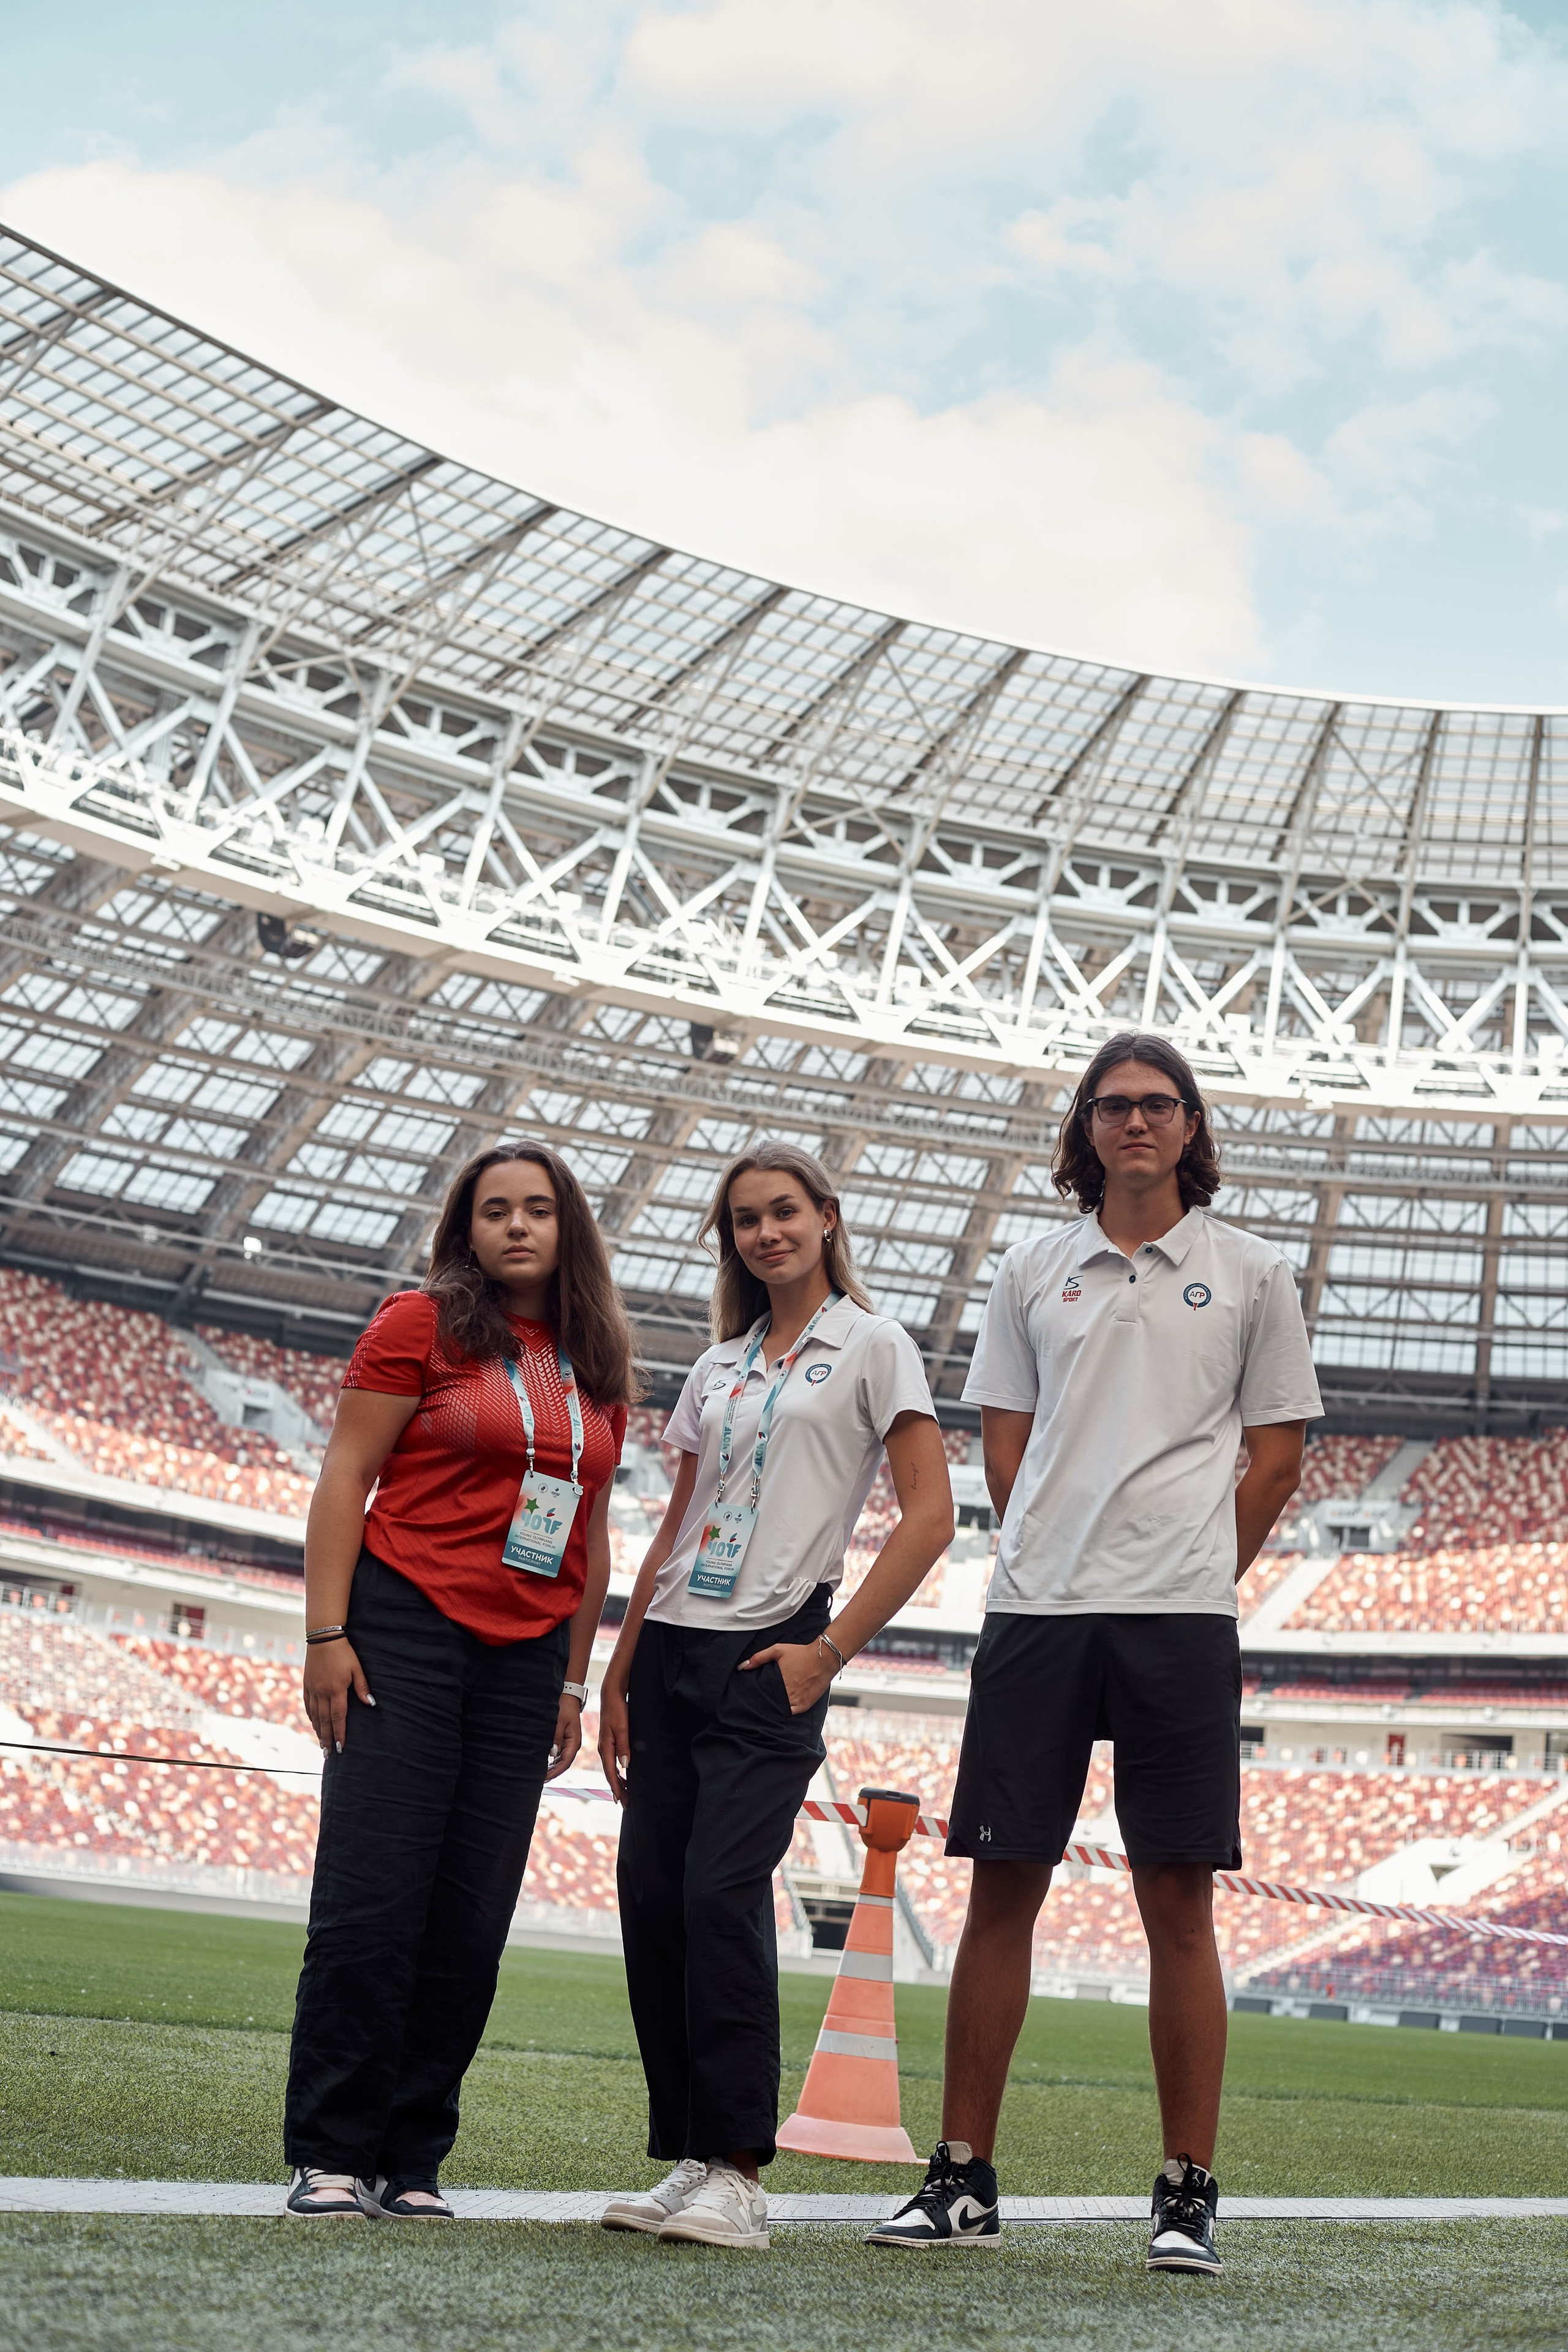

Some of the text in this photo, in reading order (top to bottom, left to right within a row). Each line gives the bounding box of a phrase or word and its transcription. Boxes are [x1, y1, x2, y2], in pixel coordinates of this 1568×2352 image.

[514, 1534, 541, 1545] INTERNATIONAL
[532, 1534, 552, 1544] OLYMPIANS
[510, 1545, 554, 1565] УЧАСТНИК
[518, 1556, 541, 1566] PARTICIPANT
[696, 1574, 731, 1586] УЧАСТНИК
